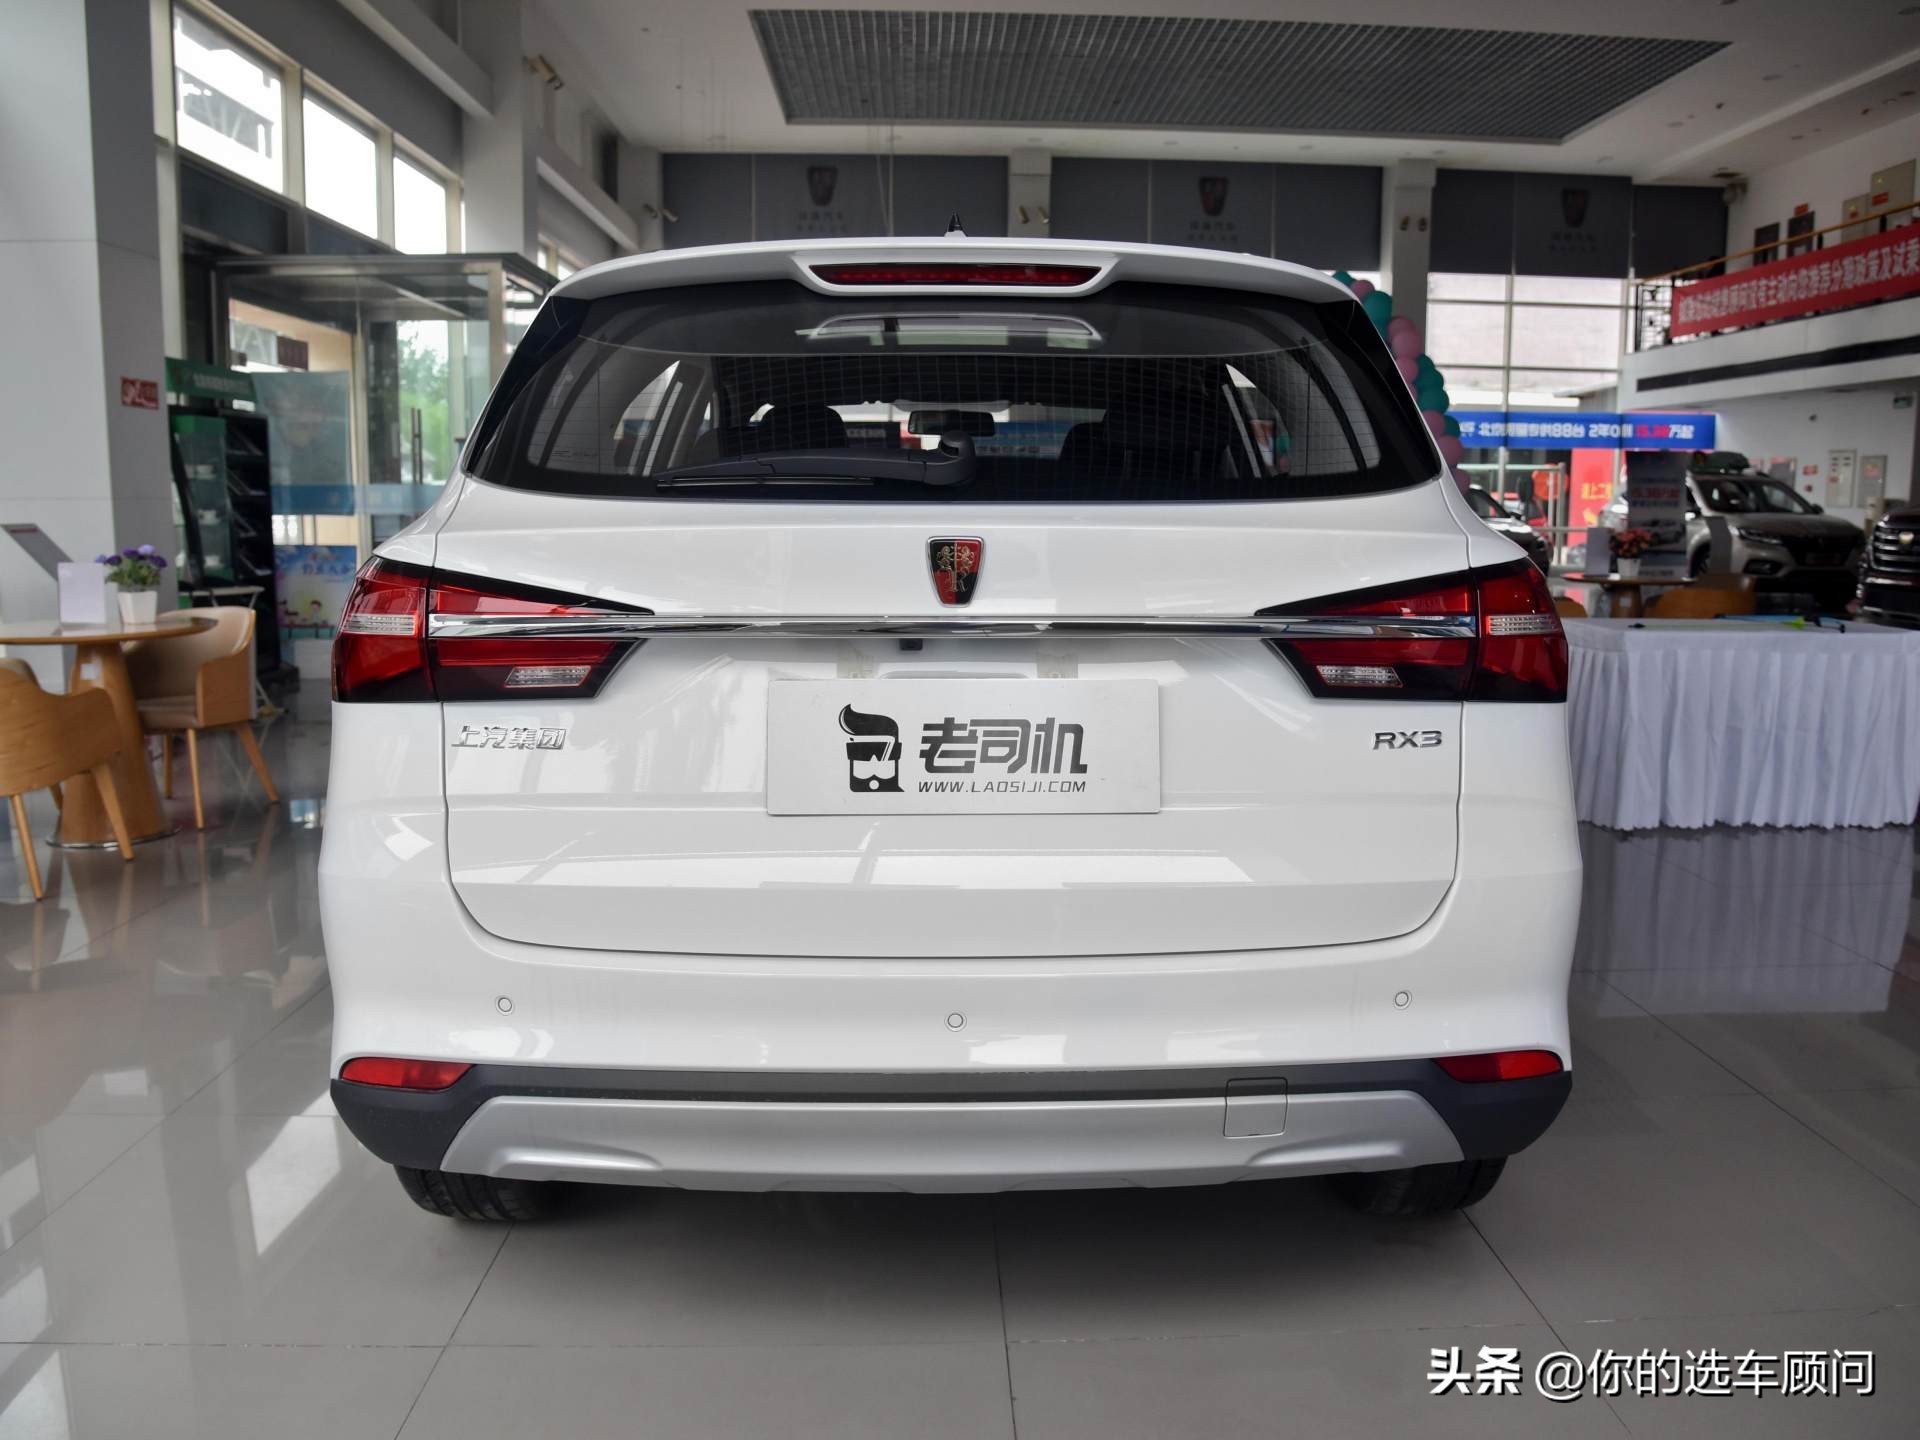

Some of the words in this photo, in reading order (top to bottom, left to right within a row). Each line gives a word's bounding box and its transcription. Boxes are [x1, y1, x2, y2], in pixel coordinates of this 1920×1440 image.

[451, 725, 567, 750] 上汽集团
[919, 717, 1088, 774] 老司机
[1373, 730, 1442, 750] RX3
[918, 780, 1087, 794] WWW.LAOSIJI.COM
